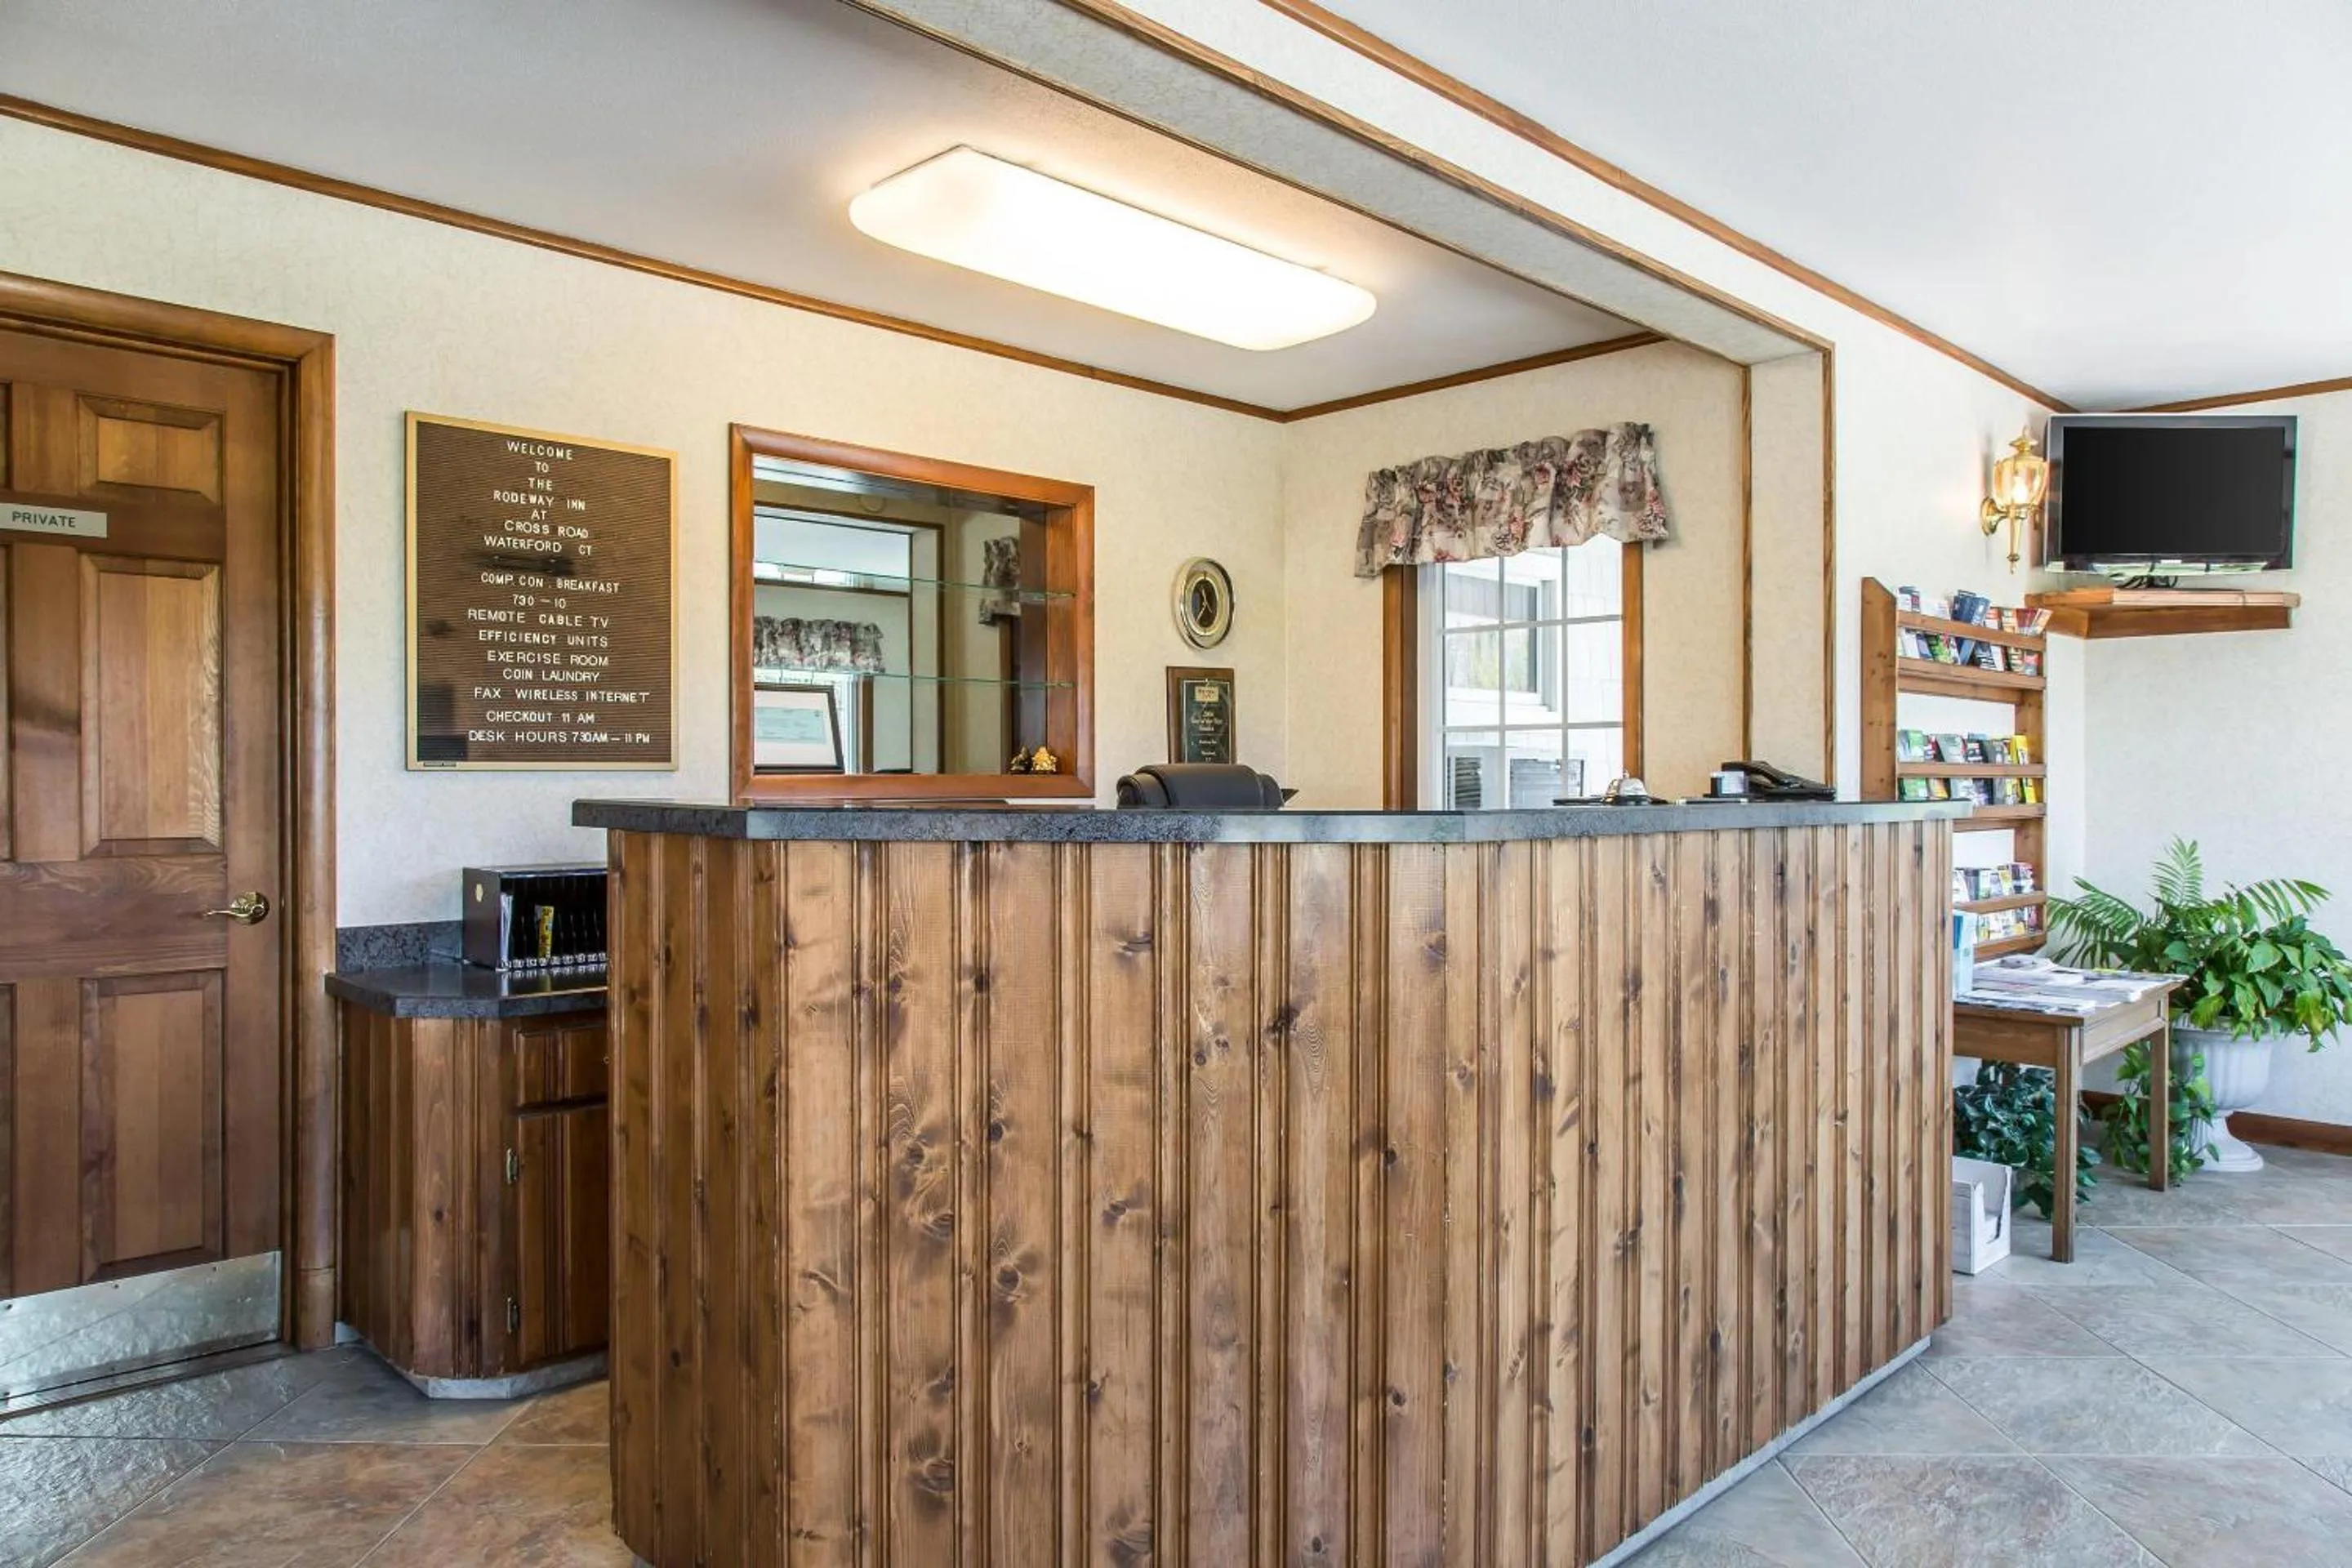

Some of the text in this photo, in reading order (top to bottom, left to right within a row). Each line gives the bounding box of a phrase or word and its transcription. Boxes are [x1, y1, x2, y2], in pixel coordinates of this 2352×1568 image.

[506, 441, 572, 460] WELCOME
[535, 461, 549, 473] TO
[528, 478, 553, 491] THE
[493, 491, 586, 511] RODEWAY INN
[11, 510, 77, 528] PRIVATE
[531, 510, 547, 520] AT
[505, 520, 589, 539] CROSS ROAD
[484, 535, 592, 555] WATERFORD CT
[556, 578, 620, 594] BREAKFAST
[468, 608, 609, 628] REMOTE CABLE TV
[479, 630, 608, 648] EFFICIENCY UNITS
[488, 650, 609, 666] EXERCISE ROOM
[503, 668, 599, 683] COIN LAUNDRY
[474, 687, 650, 703] FAX WIRELESS INTERNET
[486, 710, 595, 724] CHECKOUT 11 AM
[469, 730, 505, 742] DESK
[515, 731, 567, 742] HOURS
[625, 734, 631, 743] 11
[636, 733, 650, 743] PM
